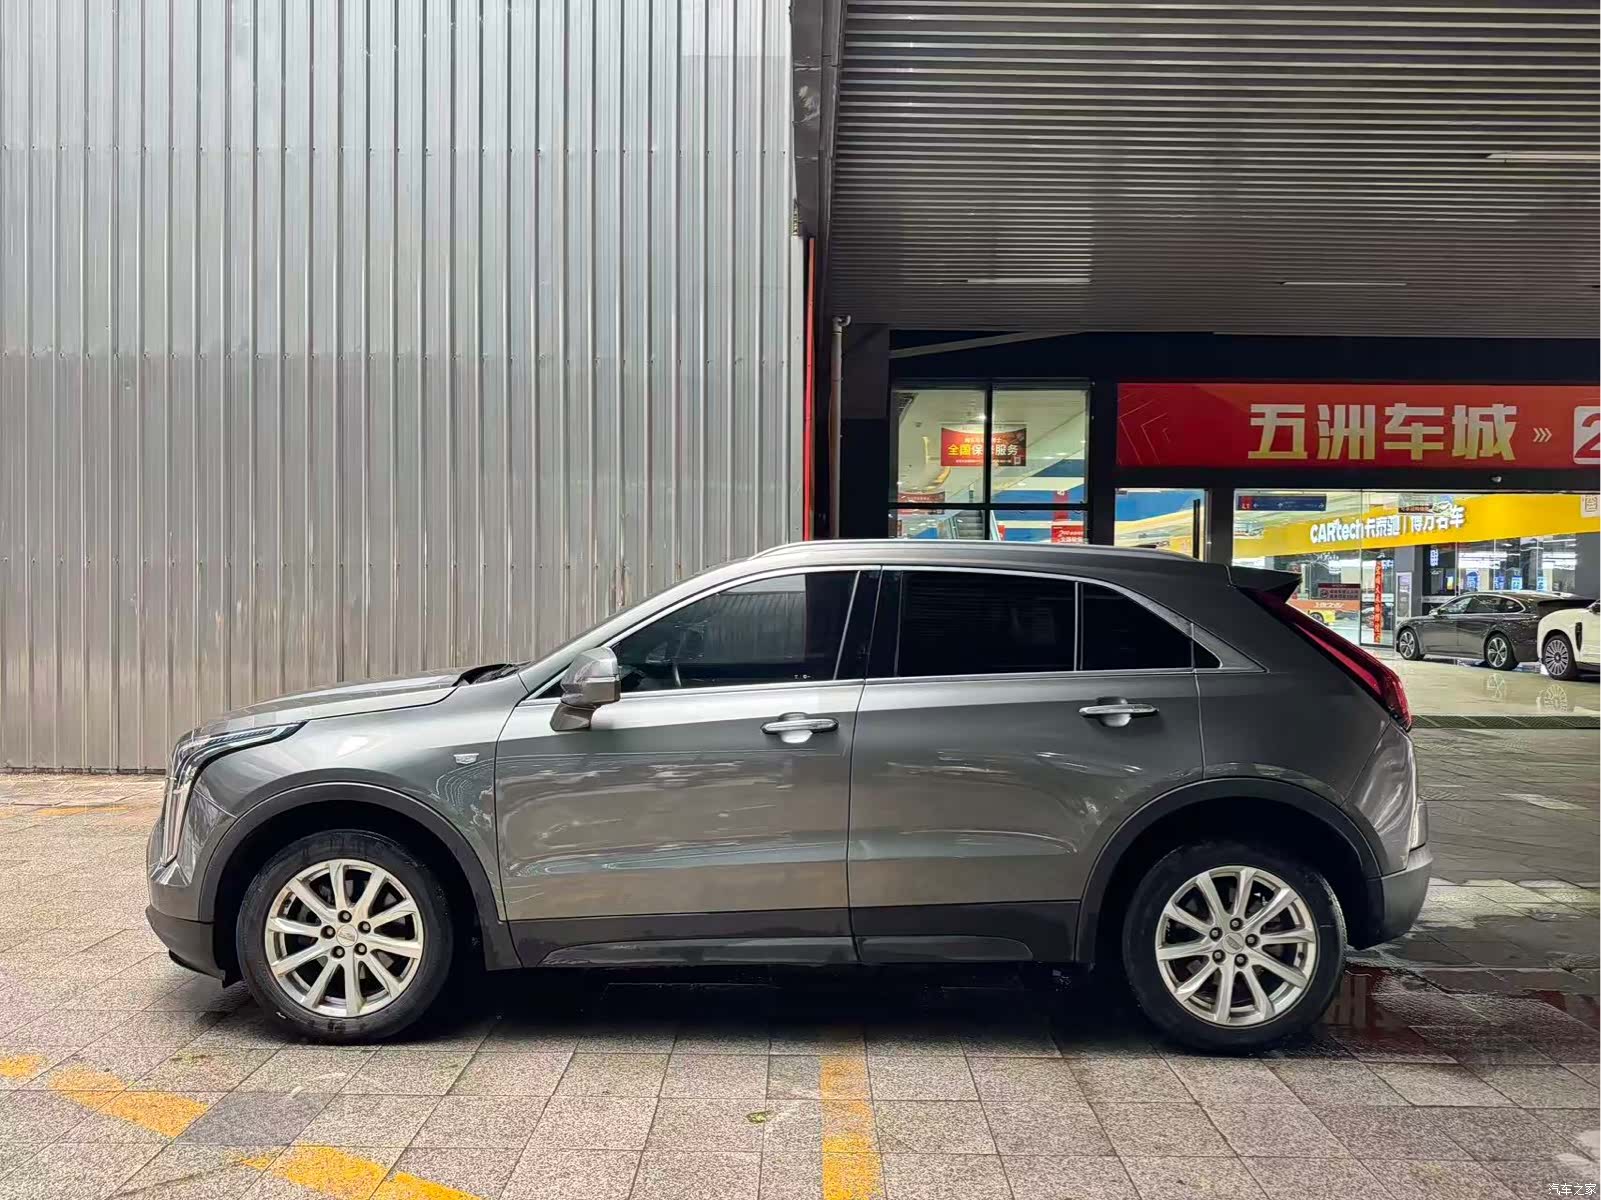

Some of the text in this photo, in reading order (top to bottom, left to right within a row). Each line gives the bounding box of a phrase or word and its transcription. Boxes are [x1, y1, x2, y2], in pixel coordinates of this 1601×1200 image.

[1248, 403, 1517, 460] 五洲车城
[948, 444, 1019, 456] 全国保服务
